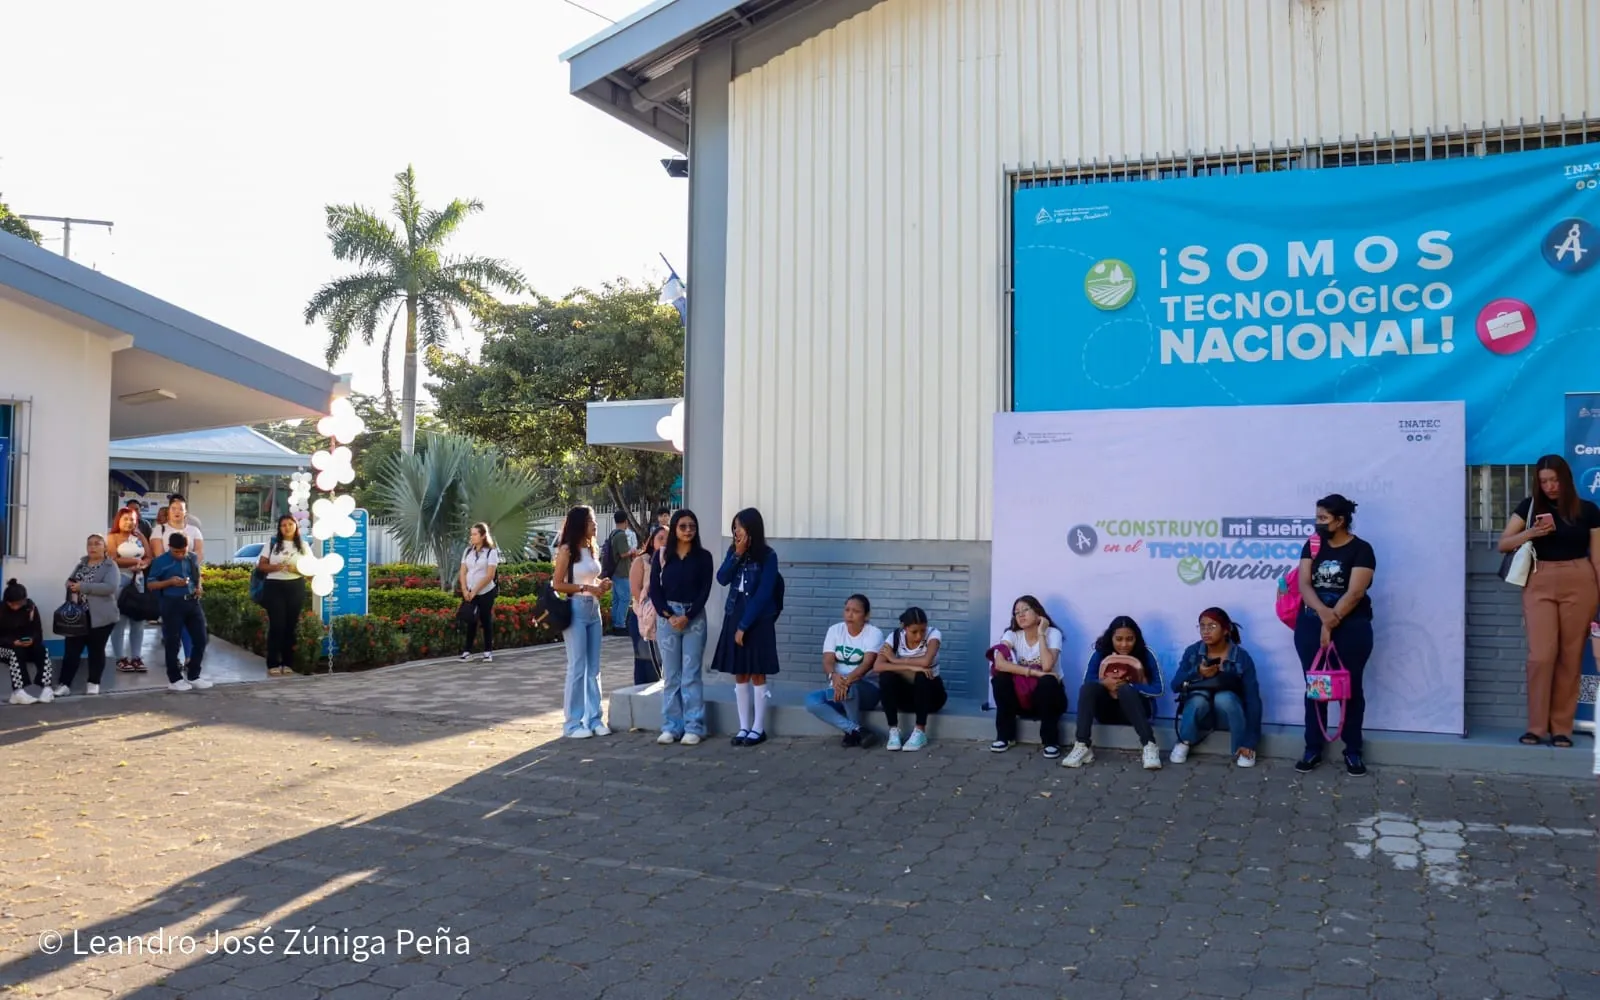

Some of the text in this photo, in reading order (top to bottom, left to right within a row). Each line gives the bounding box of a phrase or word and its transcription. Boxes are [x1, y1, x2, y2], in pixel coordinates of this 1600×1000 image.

[1159, 230, 1454, 289] ¡SOMOS
[1159, 279, 1453, 322] TECNOLÓGICO
[1160, 316, 1455, 364] NACIONAL!
[1398, 419, 1441, 428] INATEC
[1228, 519, 1253, 536] mi
[1257, 519, 1316, 536] sueño
[1103, 537, 1302, 560] en el TECNOLÓGICO
